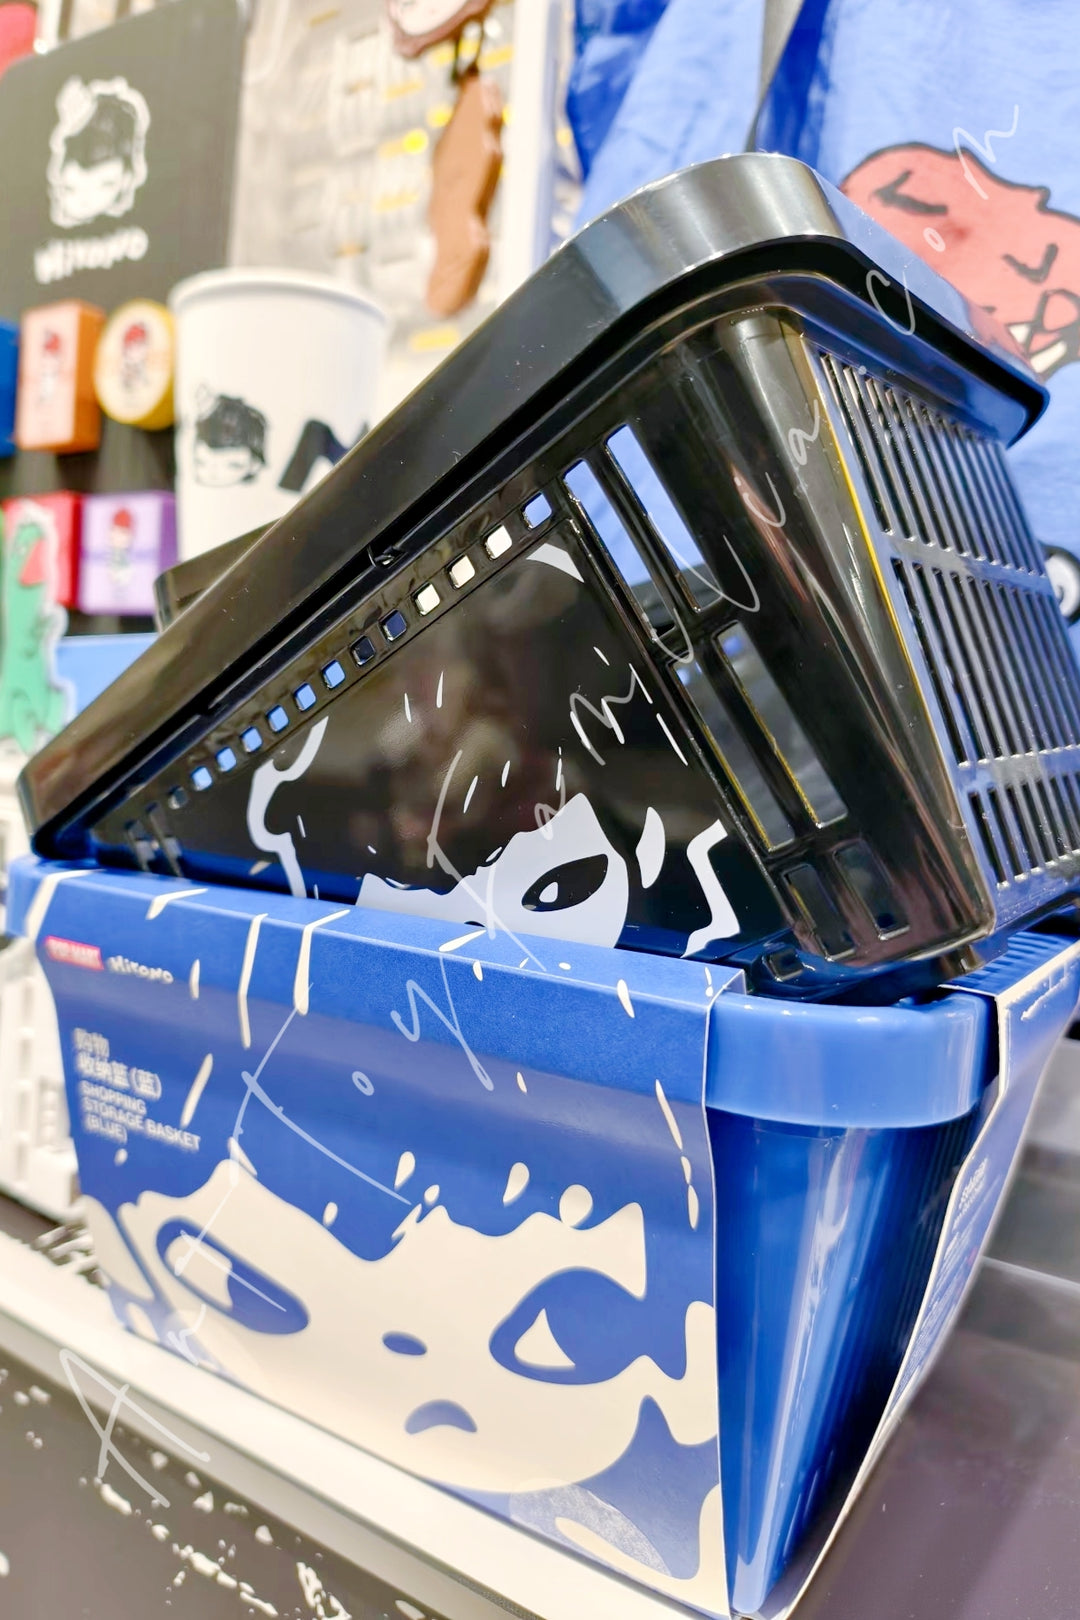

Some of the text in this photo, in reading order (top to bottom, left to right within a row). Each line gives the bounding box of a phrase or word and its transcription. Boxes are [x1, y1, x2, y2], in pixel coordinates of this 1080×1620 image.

[79, 1080, 147, 1115] SHOPPING
[82, 1096, 201, 1151] STORAGE BASKET
[84, 1113, 128, 1144] (BLUE)
